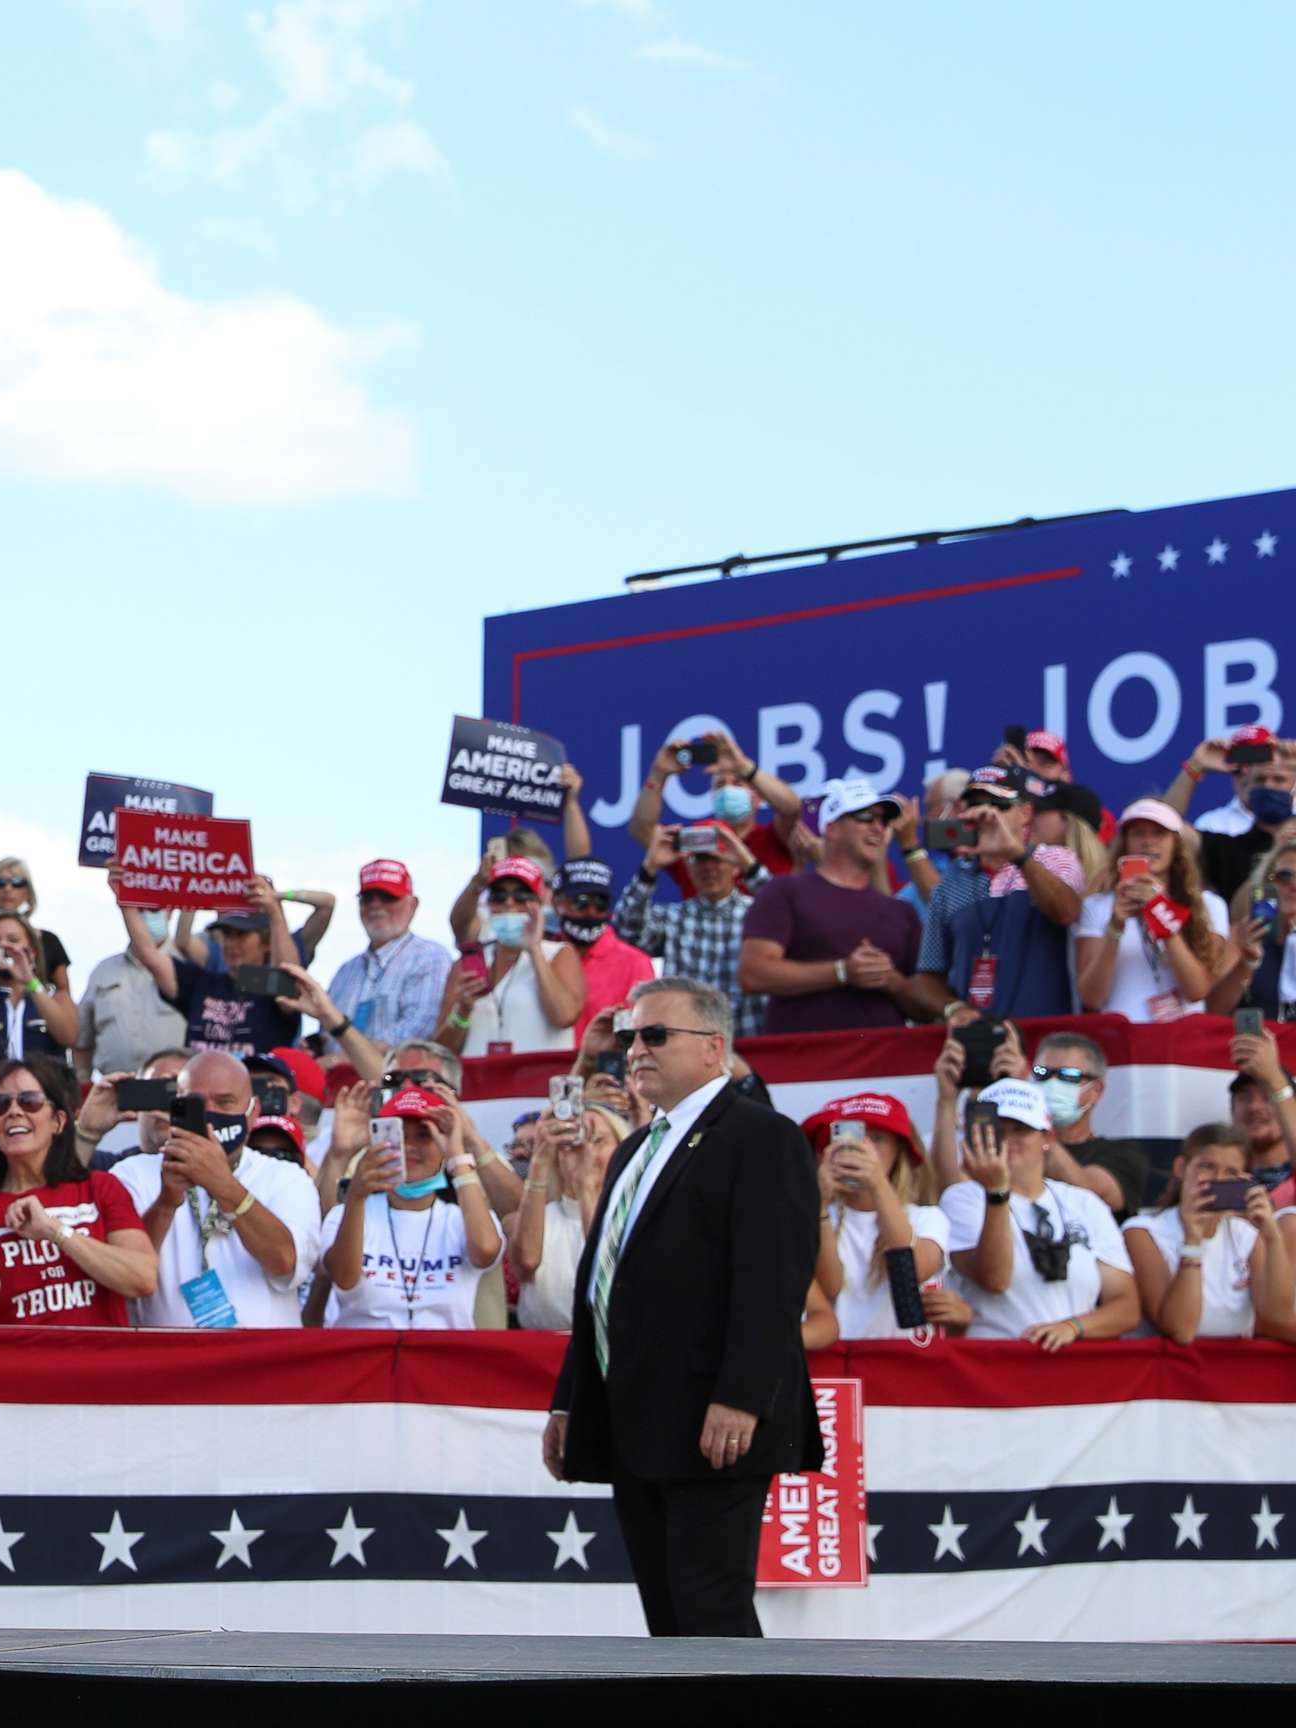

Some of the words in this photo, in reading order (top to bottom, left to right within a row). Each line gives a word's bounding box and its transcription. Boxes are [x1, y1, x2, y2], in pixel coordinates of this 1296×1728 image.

[486, 734, 538, 759] MAKE
[451, 748, 562, 787] AMERICA
[124, 794, 177, 813] MAKE
[448, 773, 507, 797] GREAT
[505, 784, 563, 808] AGAIN
[155, 827, 208, 848] MAKE
[121, 845, 247, 875] AMERICA
[122, 871, 182, 892] GREAT
[187, 878, 249, 895] AGAIN
[40, 1265, 65, 1280] FOR
[362, 1254, 462, 1271] TRUMP
[12, 1280, 95, 1318] TRUMP
[815, 1387, 838, 1478] AGAIN
[816, 1483, 842, 1578] GREAT
